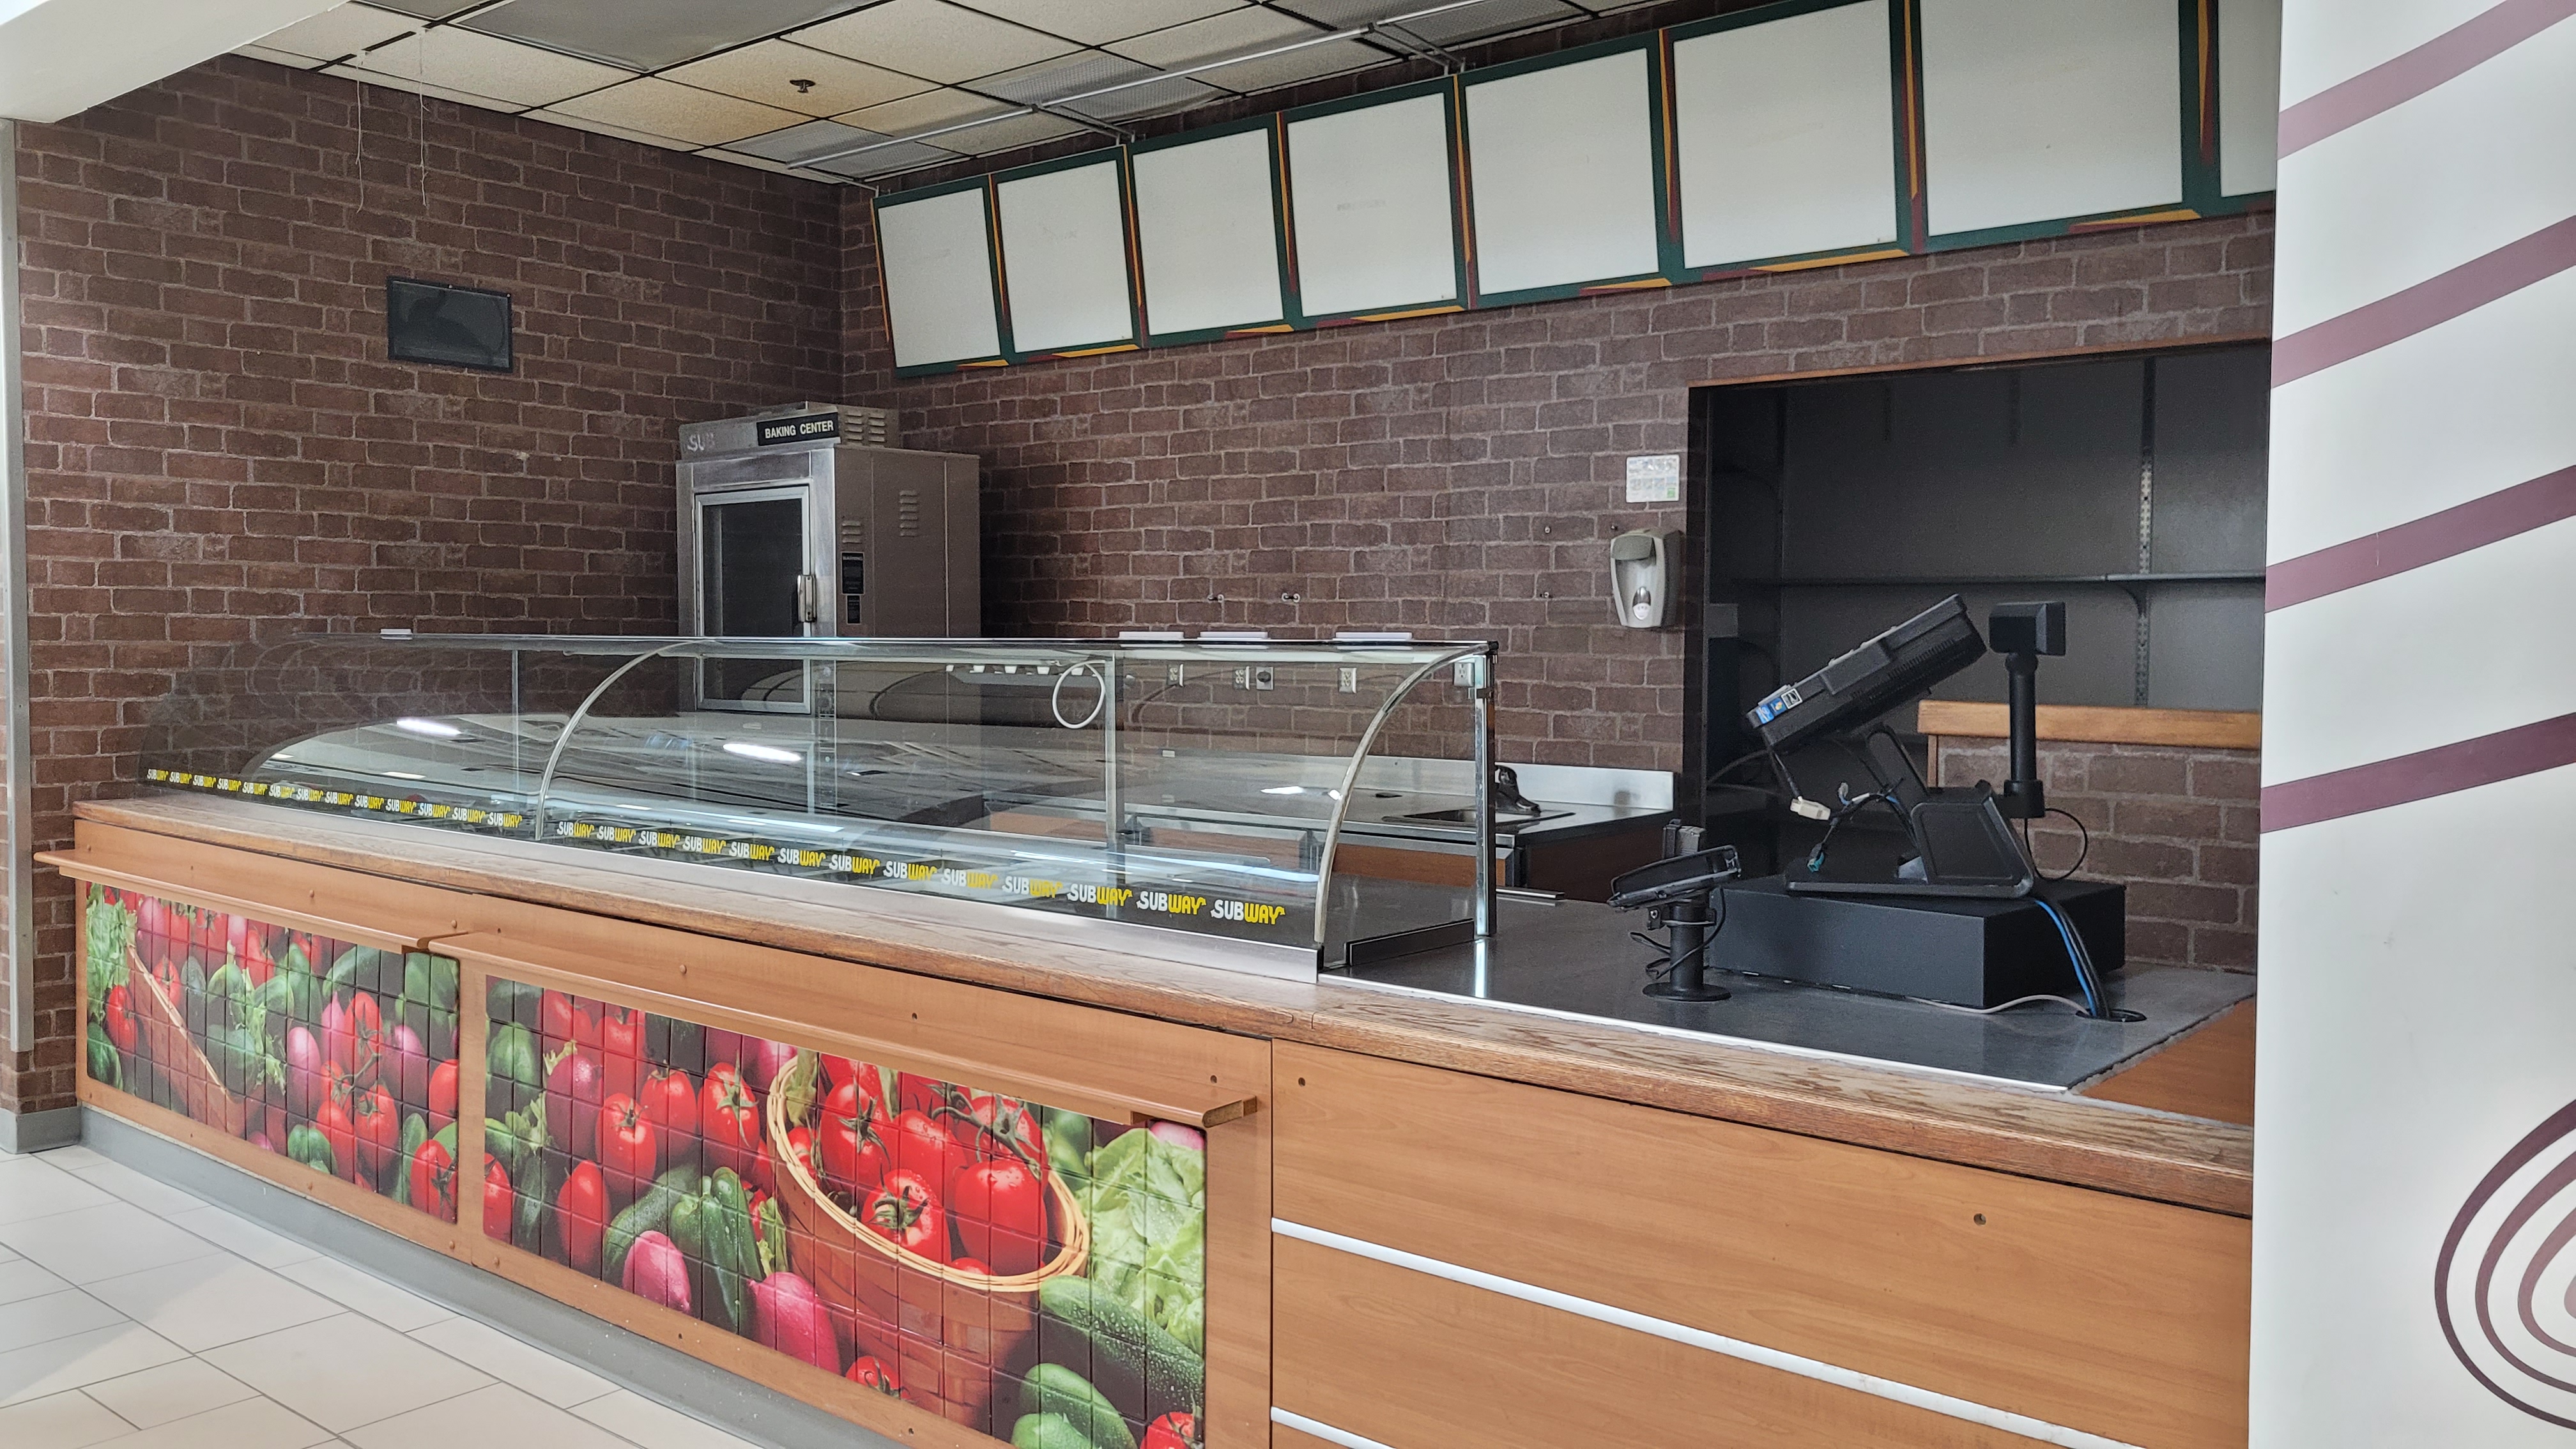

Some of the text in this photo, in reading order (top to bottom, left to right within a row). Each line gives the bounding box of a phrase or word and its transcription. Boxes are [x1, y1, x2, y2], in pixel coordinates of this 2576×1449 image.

[765, 420, 834, 439] BAKING CENTER
[147, 769, 523, 828] SUBWAY SUBWAY SUBWAY SUBWAY SUBWAY SUBWAY SUBWAY SUBWAY SUBWAY SUBWAY SUBWAY SUBWAY SUBWAY
[556, 821, 1285, 924] SUBWAY SUBWAY SUBWAY SUBWAY SUBWAY SUBWAY SUBWAY SUBWAY SUBWAY SUBWAY SUBWAY SUBWAY SUBWAY
